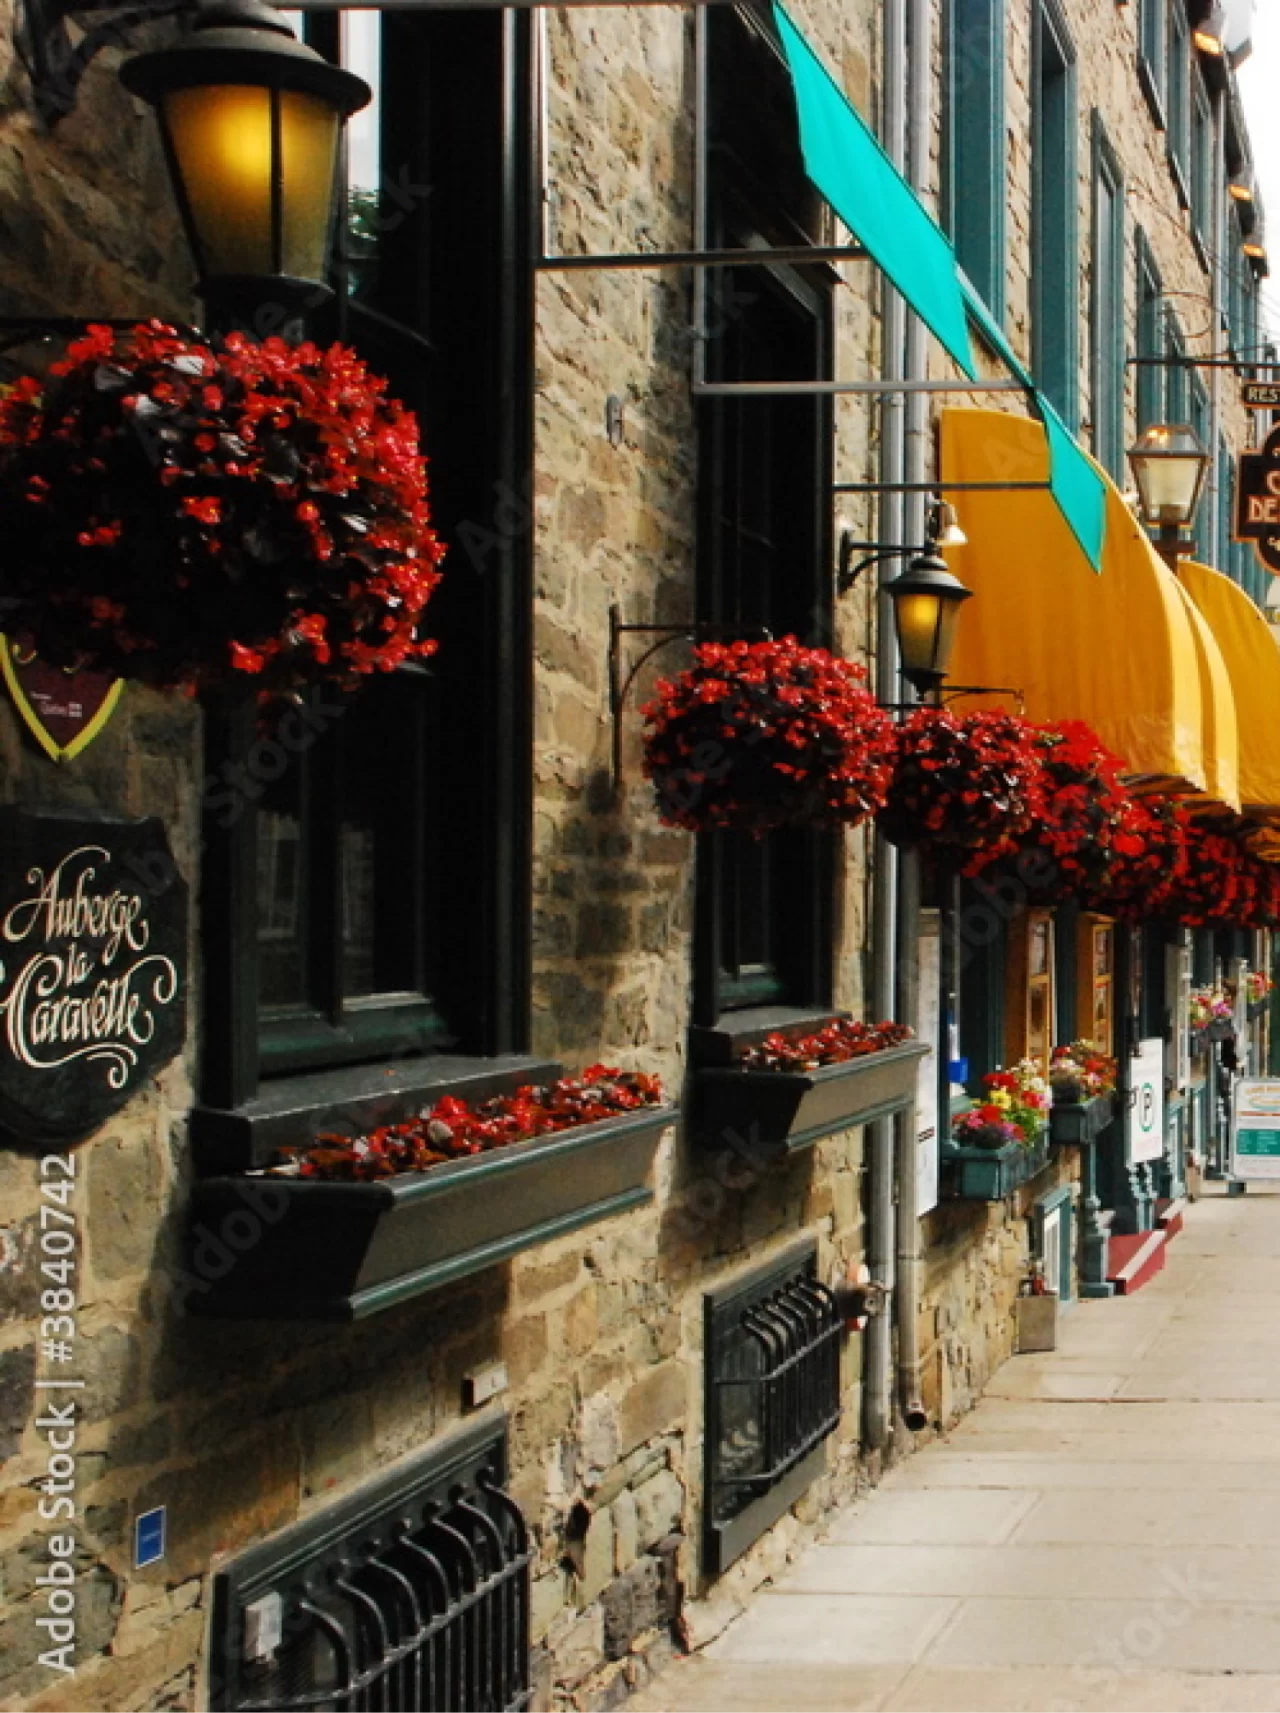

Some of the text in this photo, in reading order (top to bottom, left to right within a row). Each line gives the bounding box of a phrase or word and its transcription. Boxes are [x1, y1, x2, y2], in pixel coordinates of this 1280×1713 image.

[1249, 499, 1278, 524] DE
[3, 845, 150, 966] Auberge
[65, 942, 95, 987] la
[7, 952, 178, 1089] Caravelle
